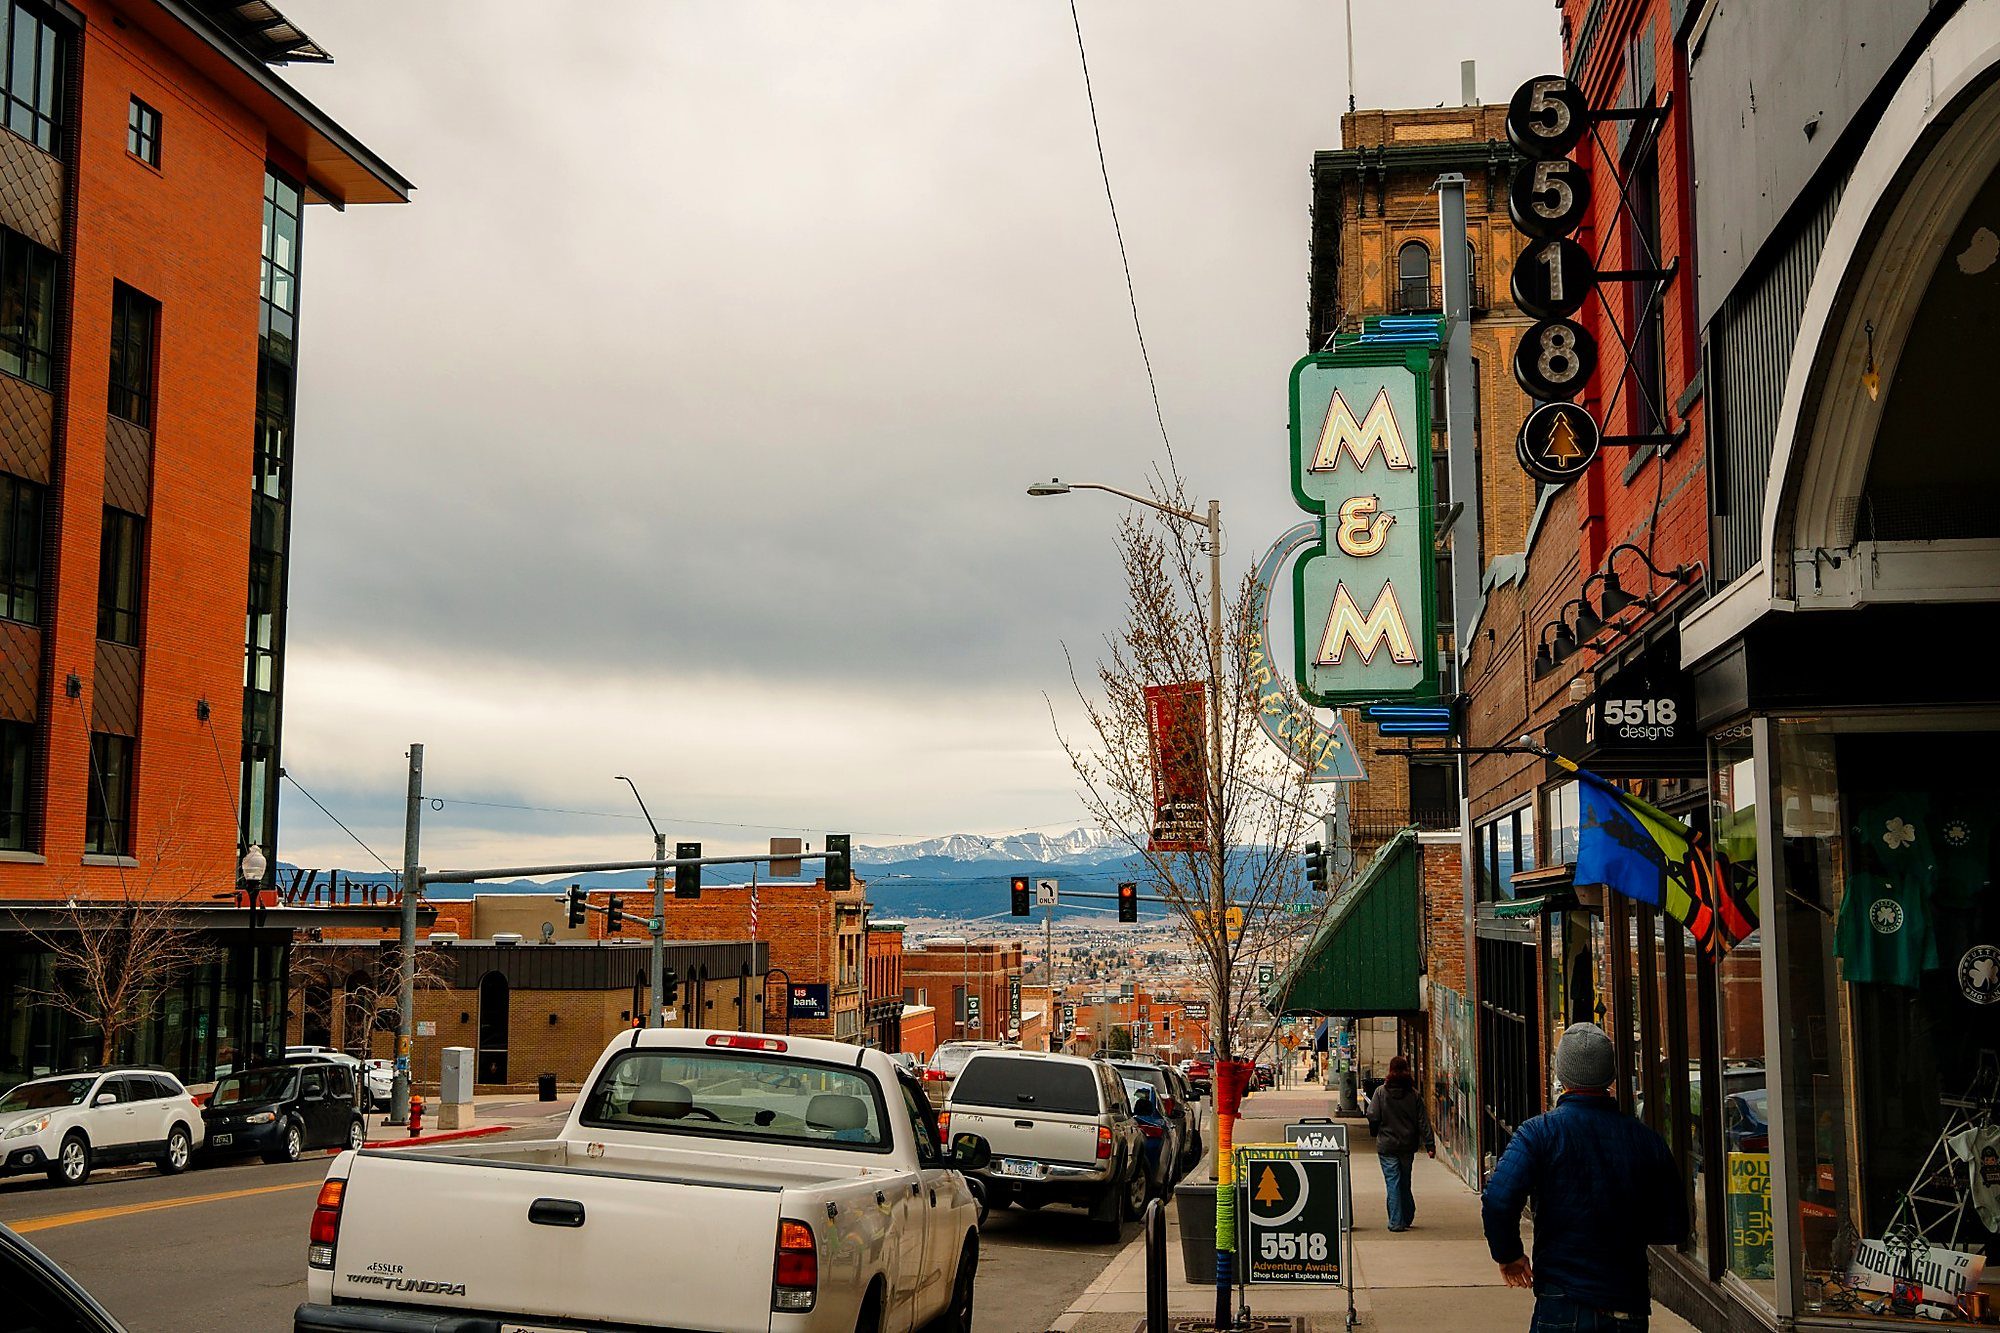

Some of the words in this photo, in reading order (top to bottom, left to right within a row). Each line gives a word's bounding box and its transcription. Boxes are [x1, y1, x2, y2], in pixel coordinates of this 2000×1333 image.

[1528, 80, 1580, 383] 5518
[1585, 703, 1596, 744] 27
[1603, 698, 1677, 725] 5518
[1619, 724, 1675, 740] designs
[793, 997, 818, 1006] bank
[1260, 1232, 1328, 1261] 5518
[1253, 1261, 1303, 1271] Adventure
[1305, 1263, 1338, 1272] Awaits
[1253, 1271, 1271, 1279] Shop
[1295, 1272, 1320, 1280] Explore
[1913, 1257, 1967, 1297] GULCH
[346, 1273, 383, 1285] TOYOTA
[382, 1276, 466, 1297] TUNDRA
